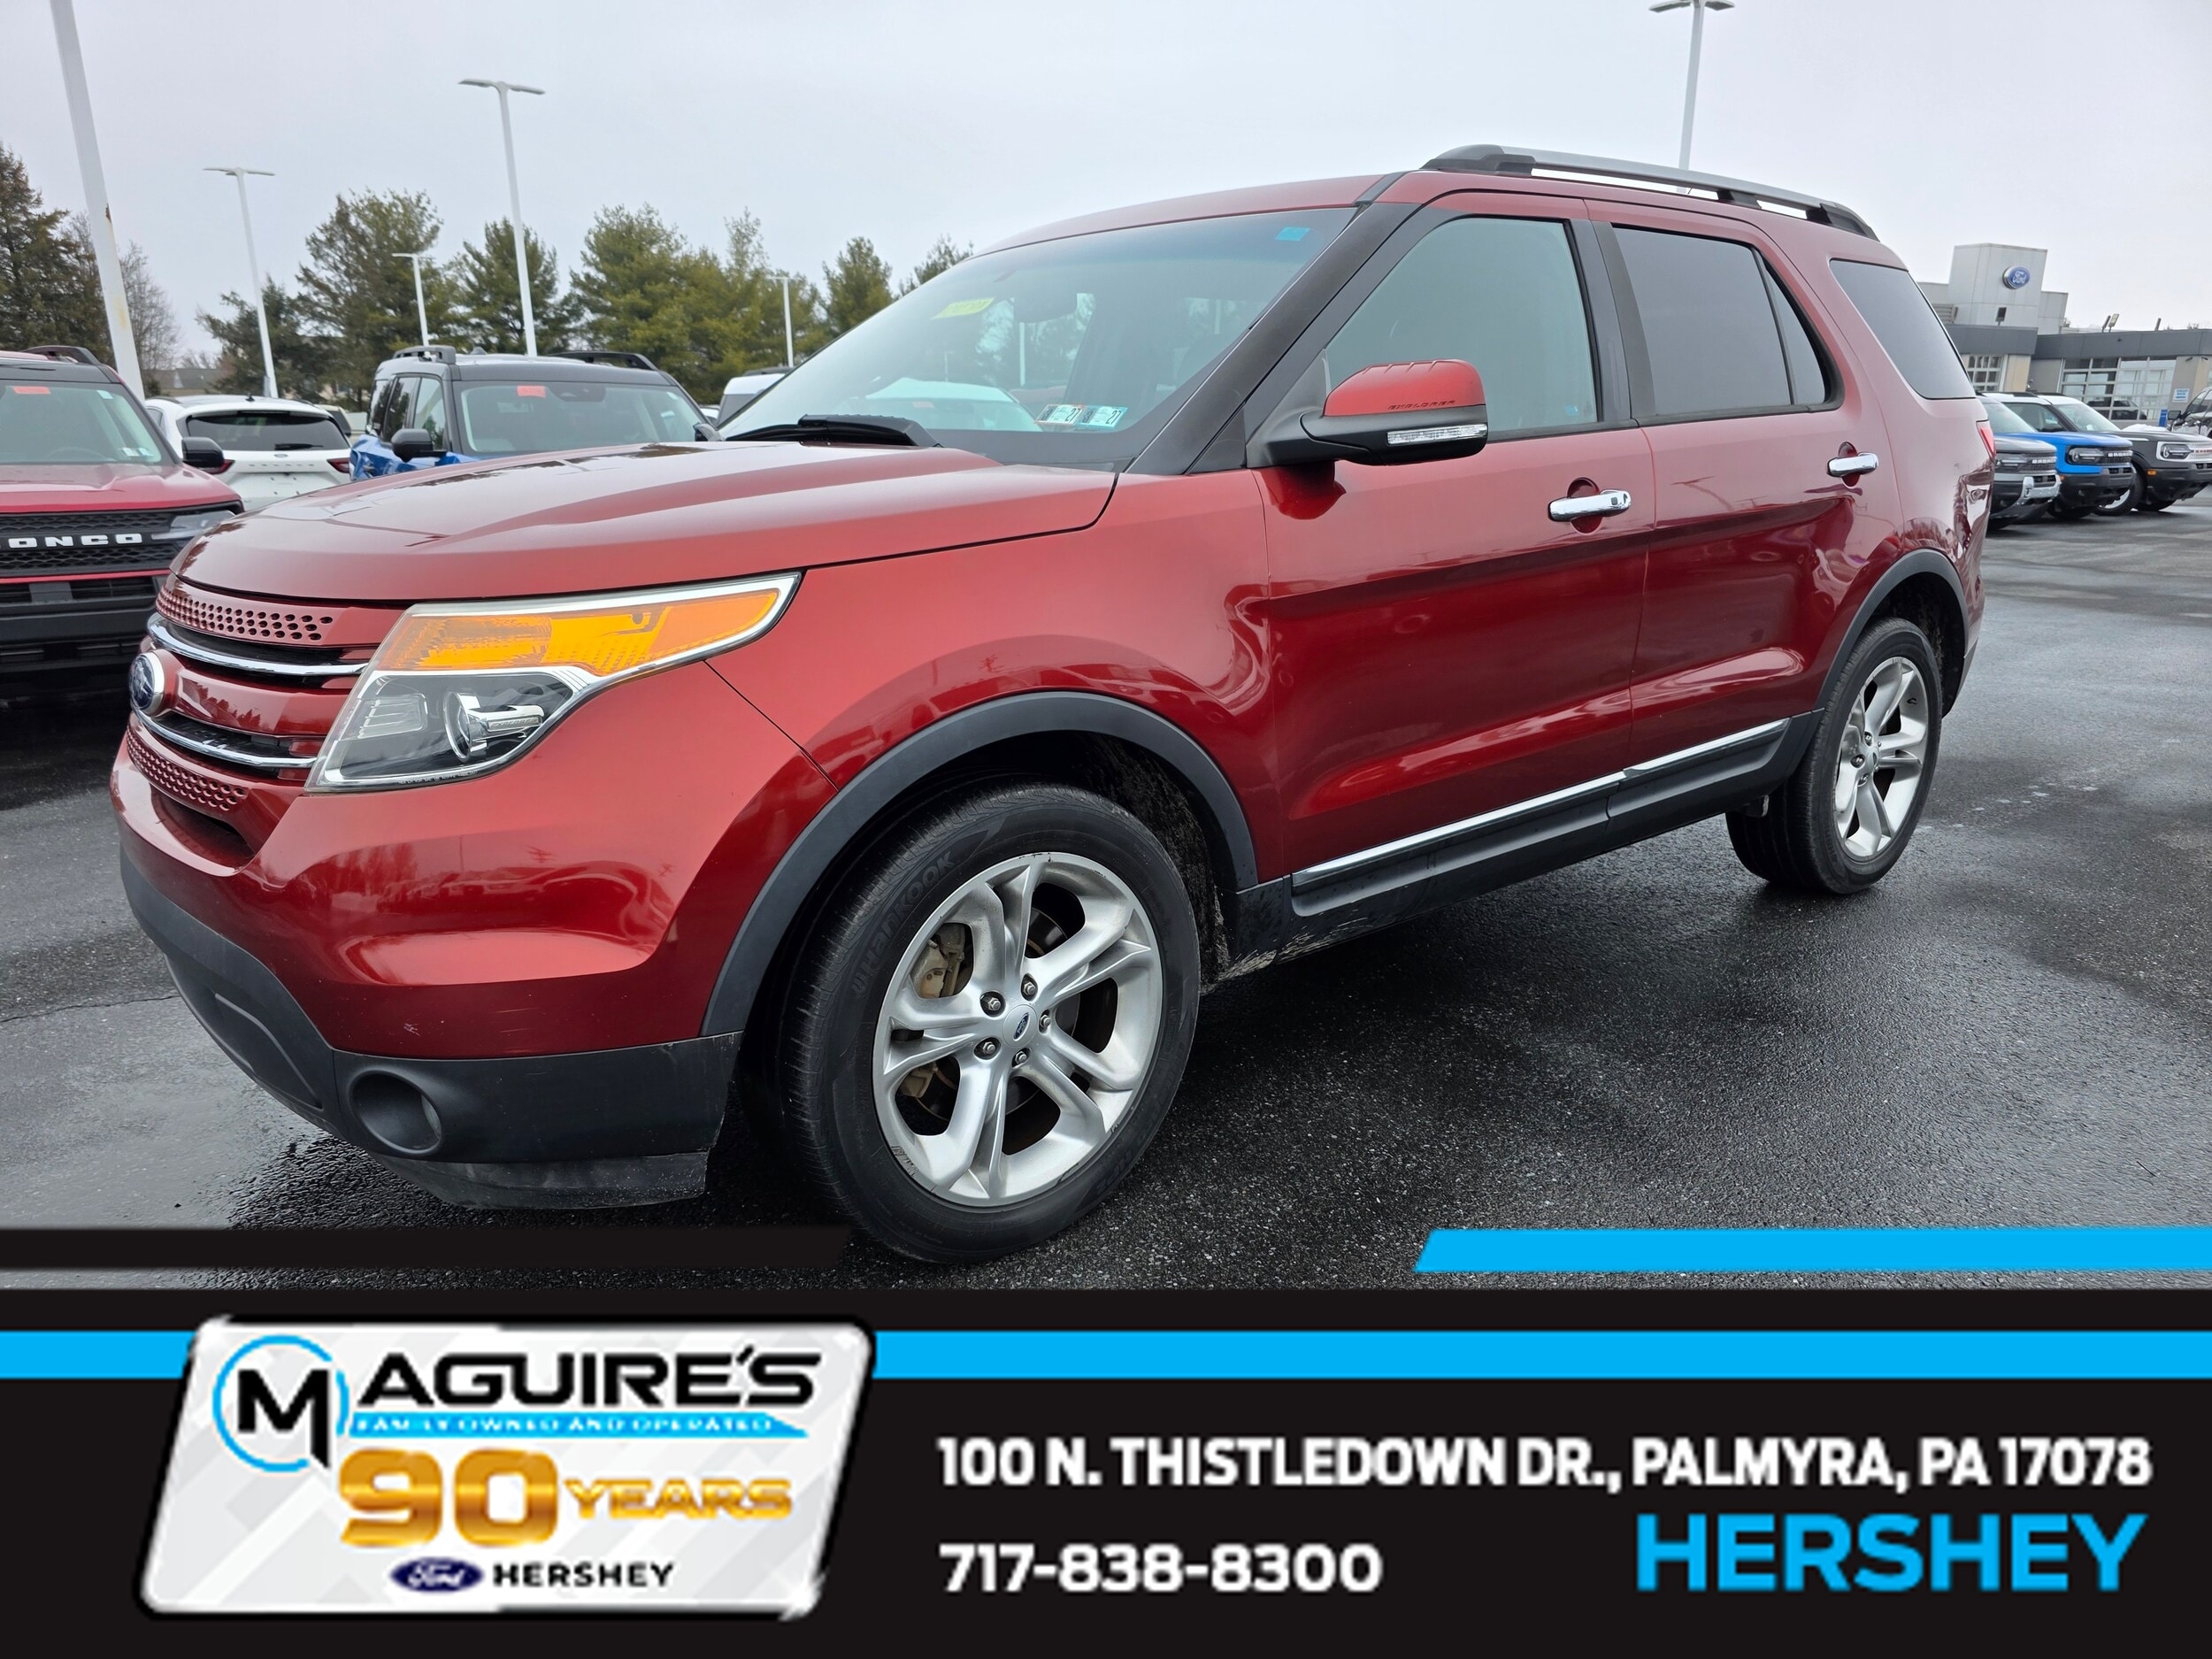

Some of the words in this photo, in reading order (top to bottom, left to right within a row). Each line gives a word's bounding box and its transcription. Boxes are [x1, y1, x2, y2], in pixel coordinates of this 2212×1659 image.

[1064, 408, 1081, 422] 27
[1106, 411, 1122, 425] 27
[8, 534, 142, 549] ONCO
